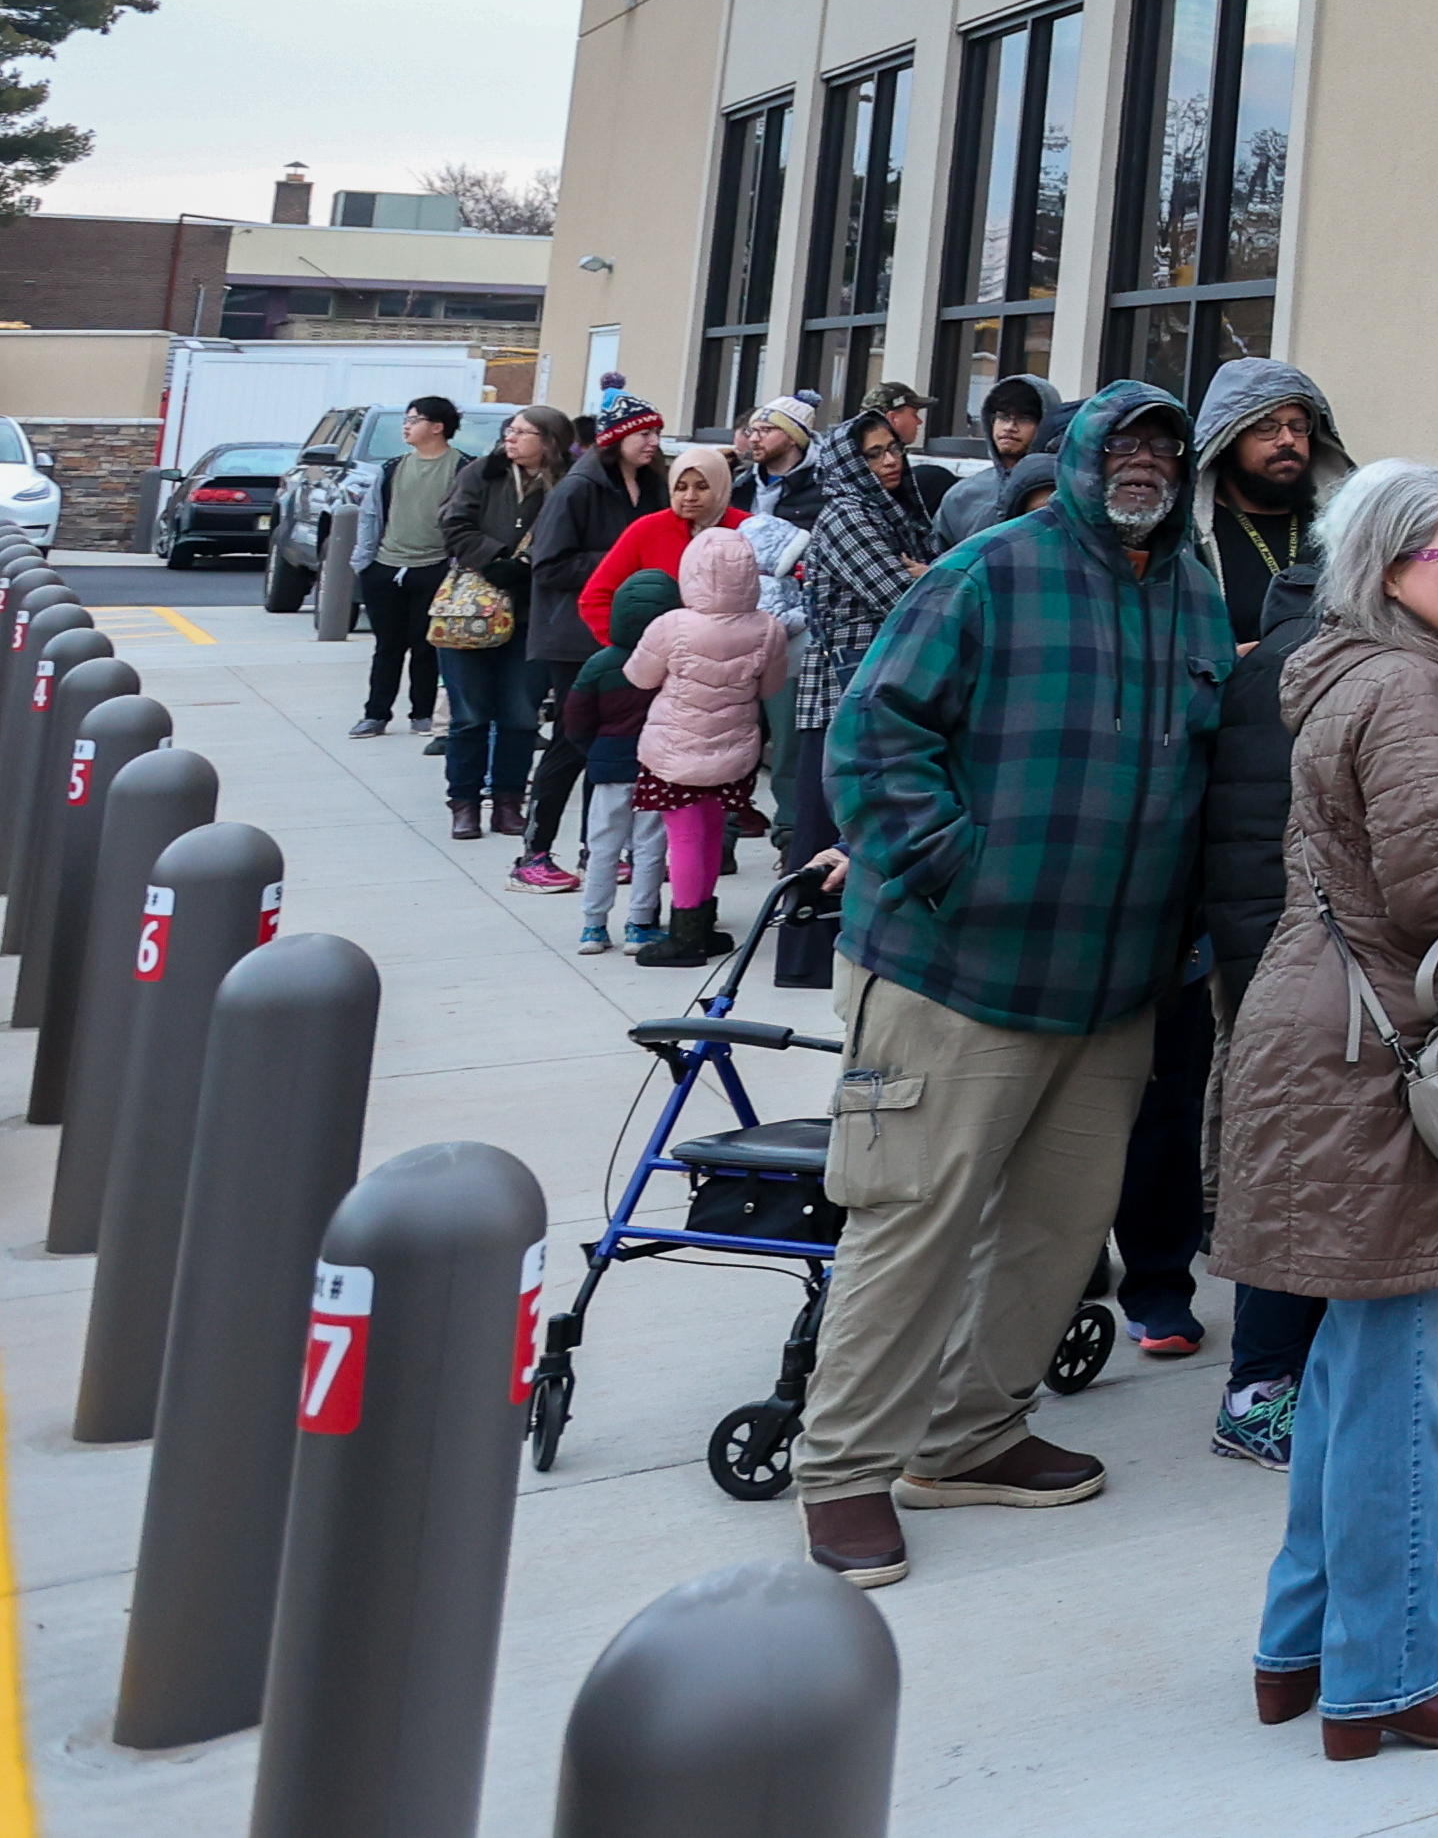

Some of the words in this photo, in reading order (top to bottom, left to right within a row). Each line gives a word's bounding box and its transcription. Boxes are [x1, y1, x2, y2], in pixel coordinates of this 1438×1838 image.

[12, 625, 23, 648] 3
[34, 678, 48, 707] 4
[68, 763, 86, 800] 5
[138, 920, 159, 973] 6
[305, 1323, 352, 1418] 7
